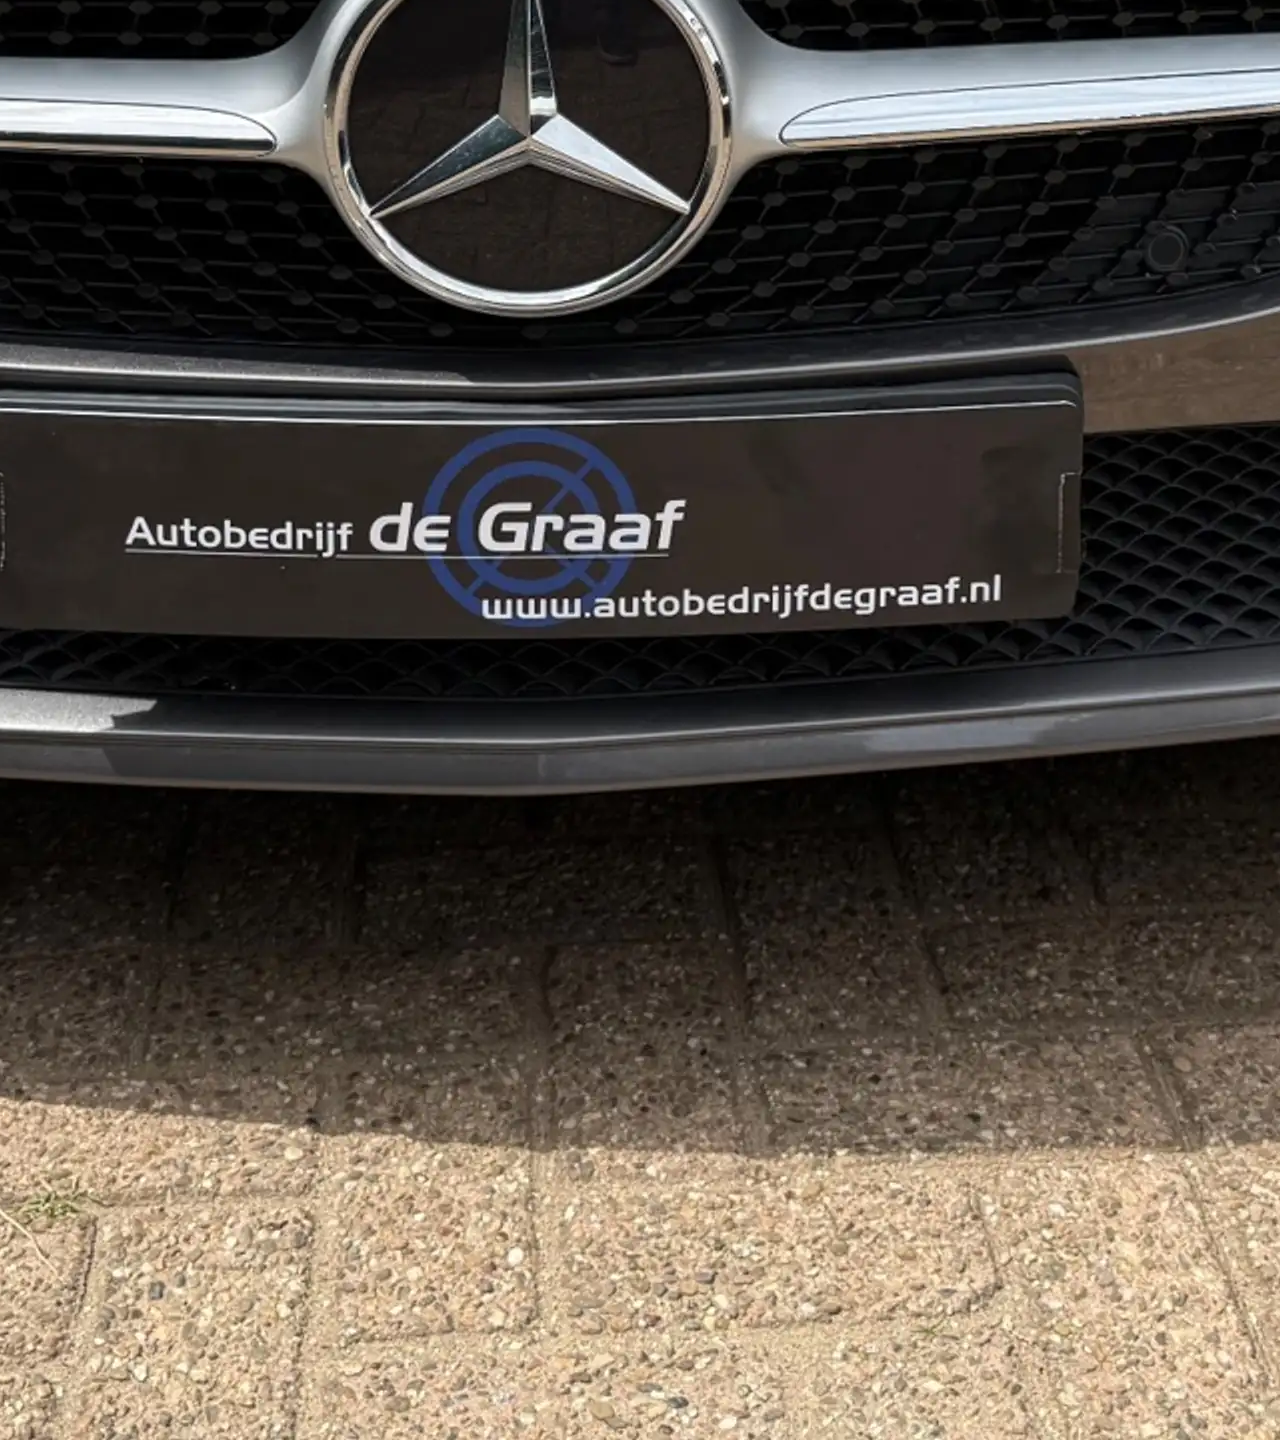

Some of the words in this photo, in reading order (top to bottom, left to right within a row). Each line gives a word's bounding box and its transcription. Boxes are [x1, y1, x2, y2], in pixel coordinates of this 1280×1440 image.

[125, 515, 354, 558] Autobedrijf
[369, 502, 451, 552] de
[477, 500, 687, 553] Graaf
[481, 574, 1002, 620] www.autobedrijfdegraaf.nl
